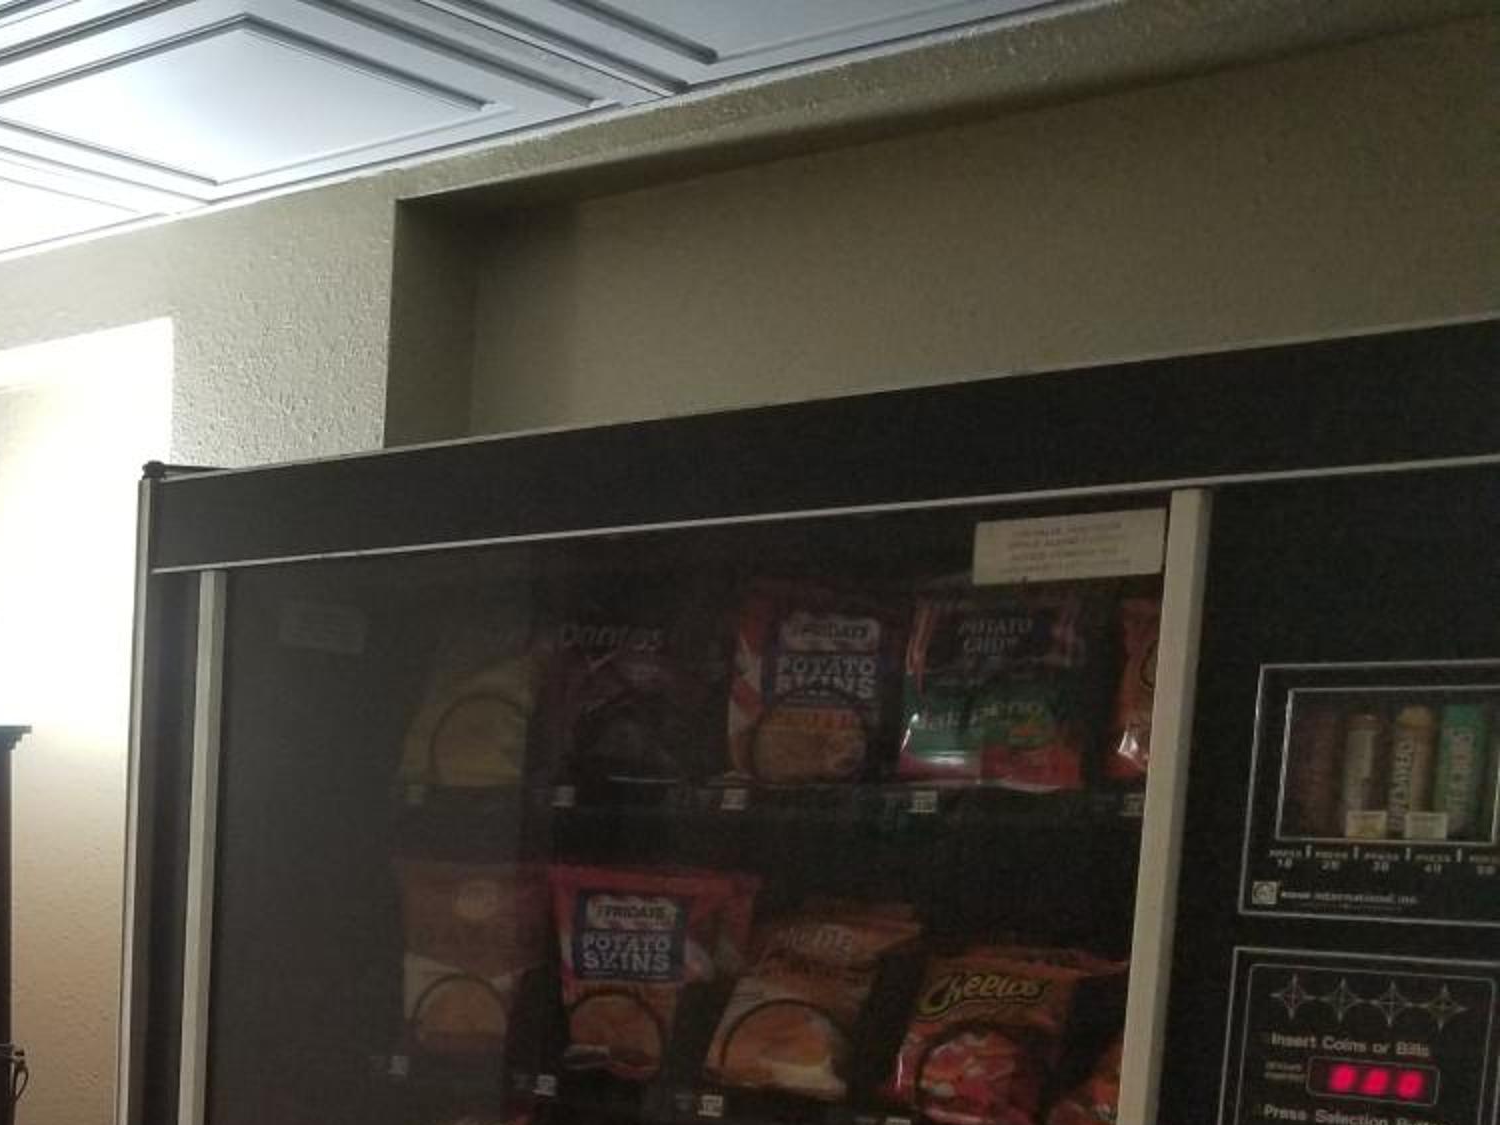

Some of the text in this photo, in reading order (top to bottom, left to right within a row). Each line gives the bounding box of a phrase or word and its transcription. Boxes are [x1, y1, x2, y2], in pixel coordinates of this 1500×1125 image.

[776, 654, 876, 677] POTATO
[581, 932, 672, 952] POTATO
[581, 949, 672, 974] SKINS
[1270, 1032, 1431, 1058] Insert Coins or Bills
[1263, 1103, 1308, 1122] Press
